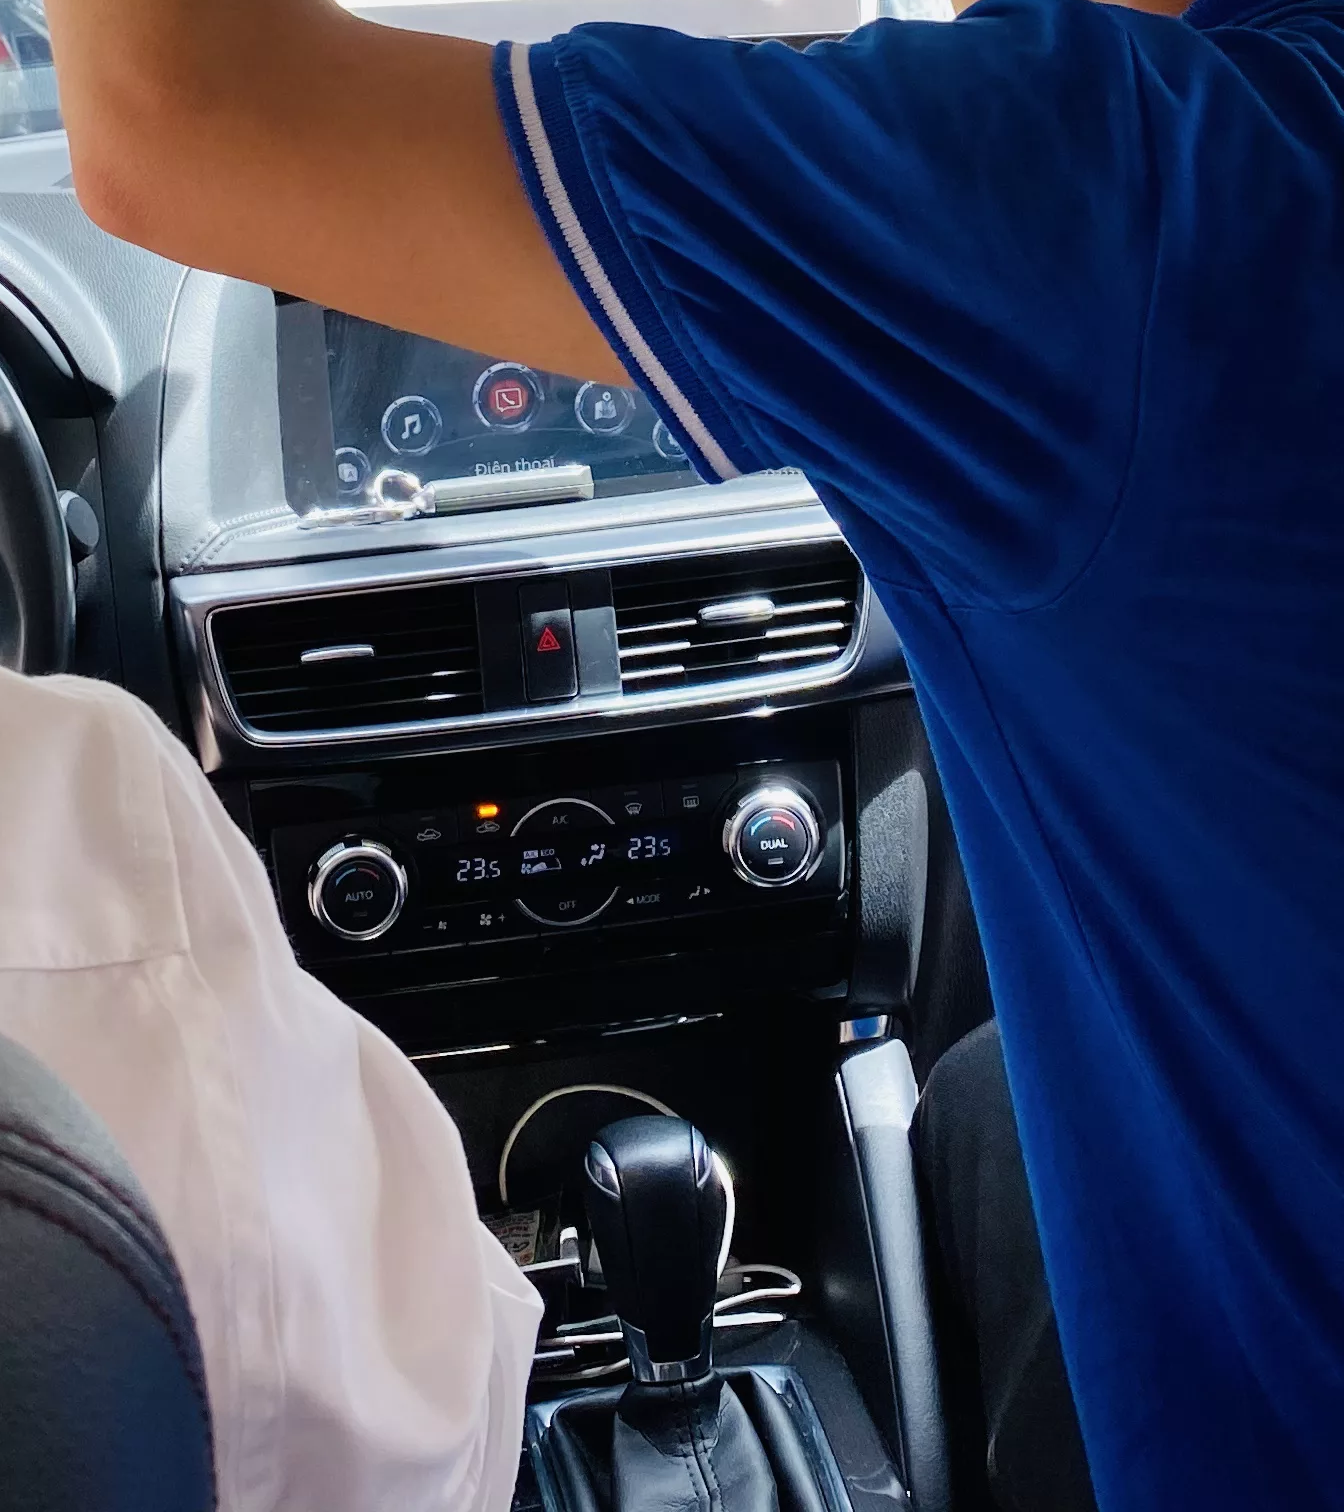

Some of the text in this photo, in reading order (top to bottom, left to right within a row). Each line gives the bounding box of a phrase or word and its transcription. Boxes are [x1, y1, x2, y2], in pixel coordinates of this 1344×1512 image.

[760, 837, 788, 851] DUAL
[456, 857, 502, 882] 23.5
[344, 890, 374, 903] AUTO
[558, 900, 577, 911] OFF
